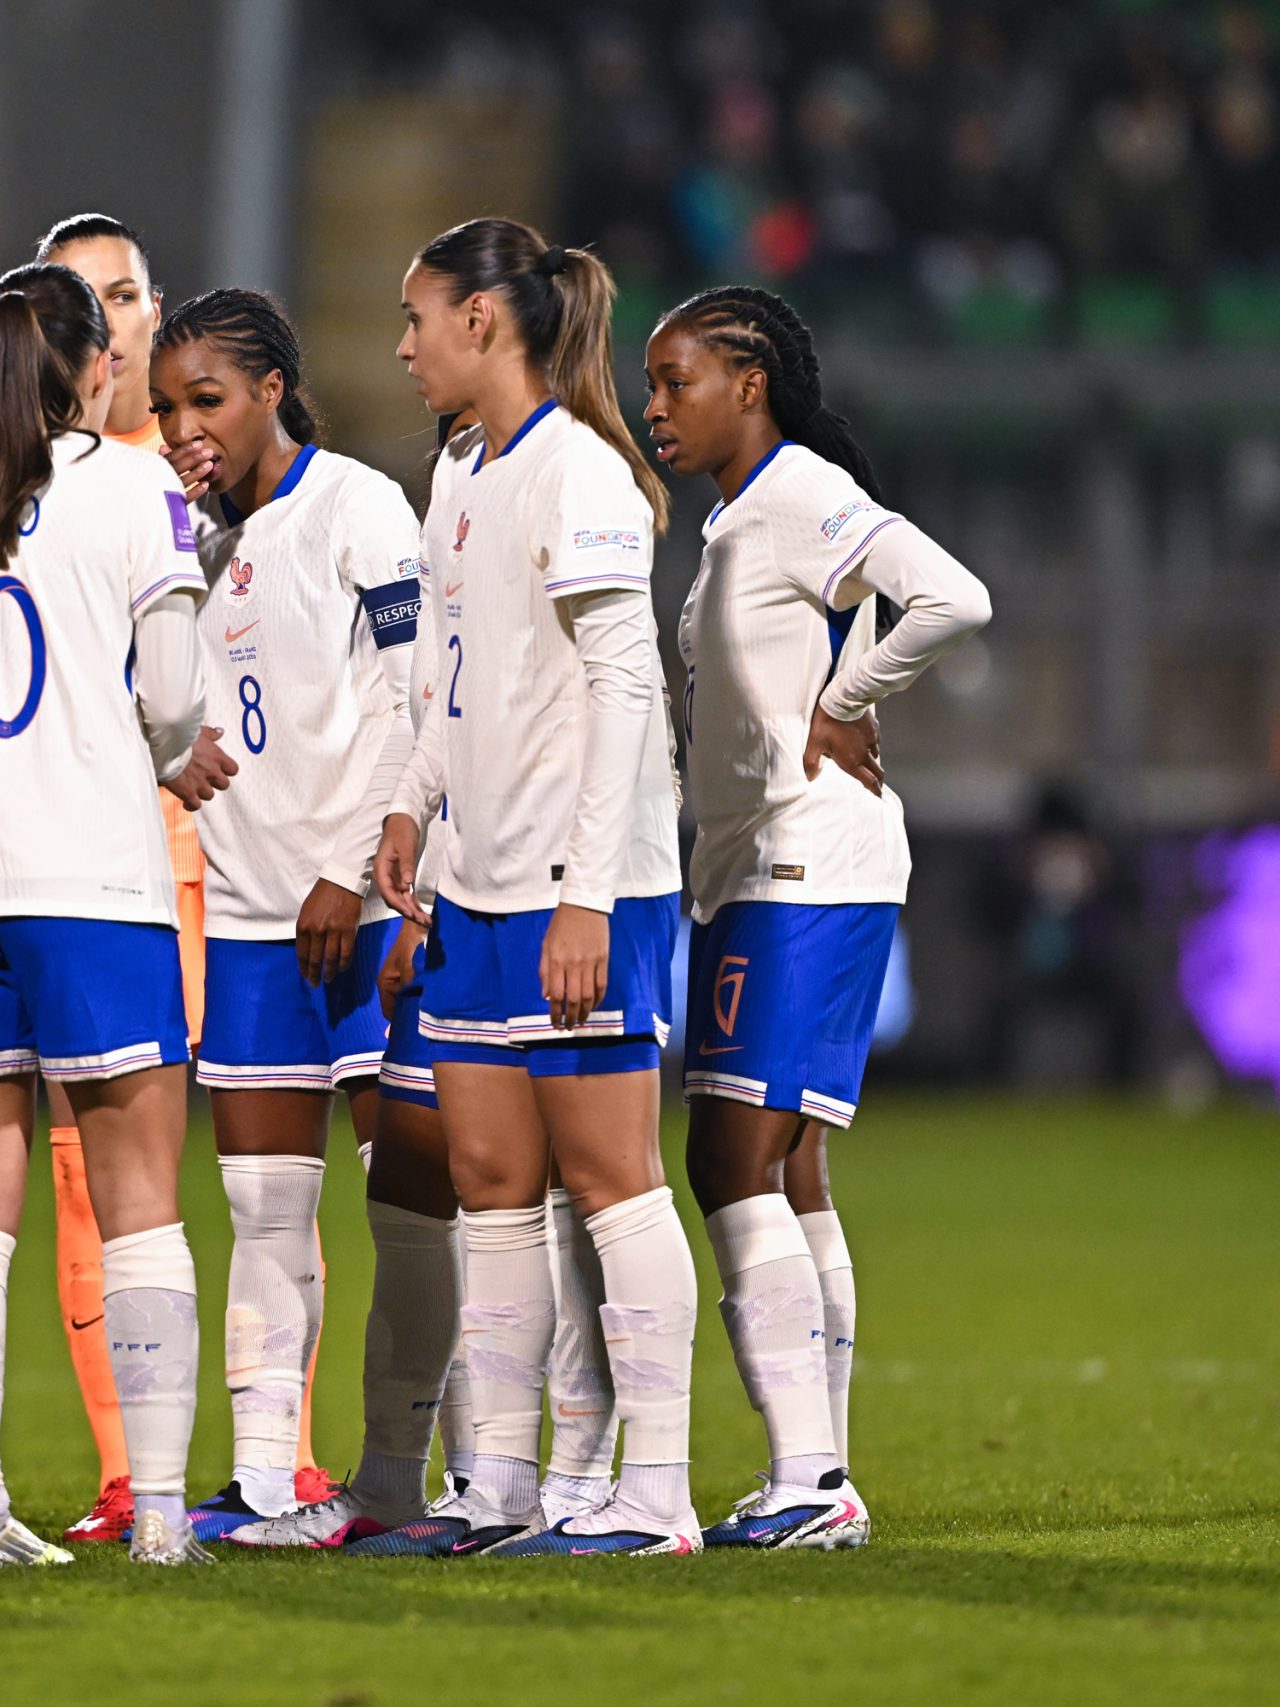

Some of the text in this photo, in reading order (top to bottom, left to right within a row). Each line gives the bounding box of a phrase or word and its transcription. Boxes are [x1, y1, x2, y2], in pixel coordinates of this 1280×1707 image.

[574, 532, 639, 545] FOUNDATION
[375, 602, 422, 626] RESPEC
[238, 674, 267, 755] 8
[448, 634, 463, 718] 2
[713, 955, 750, 1037] 6
